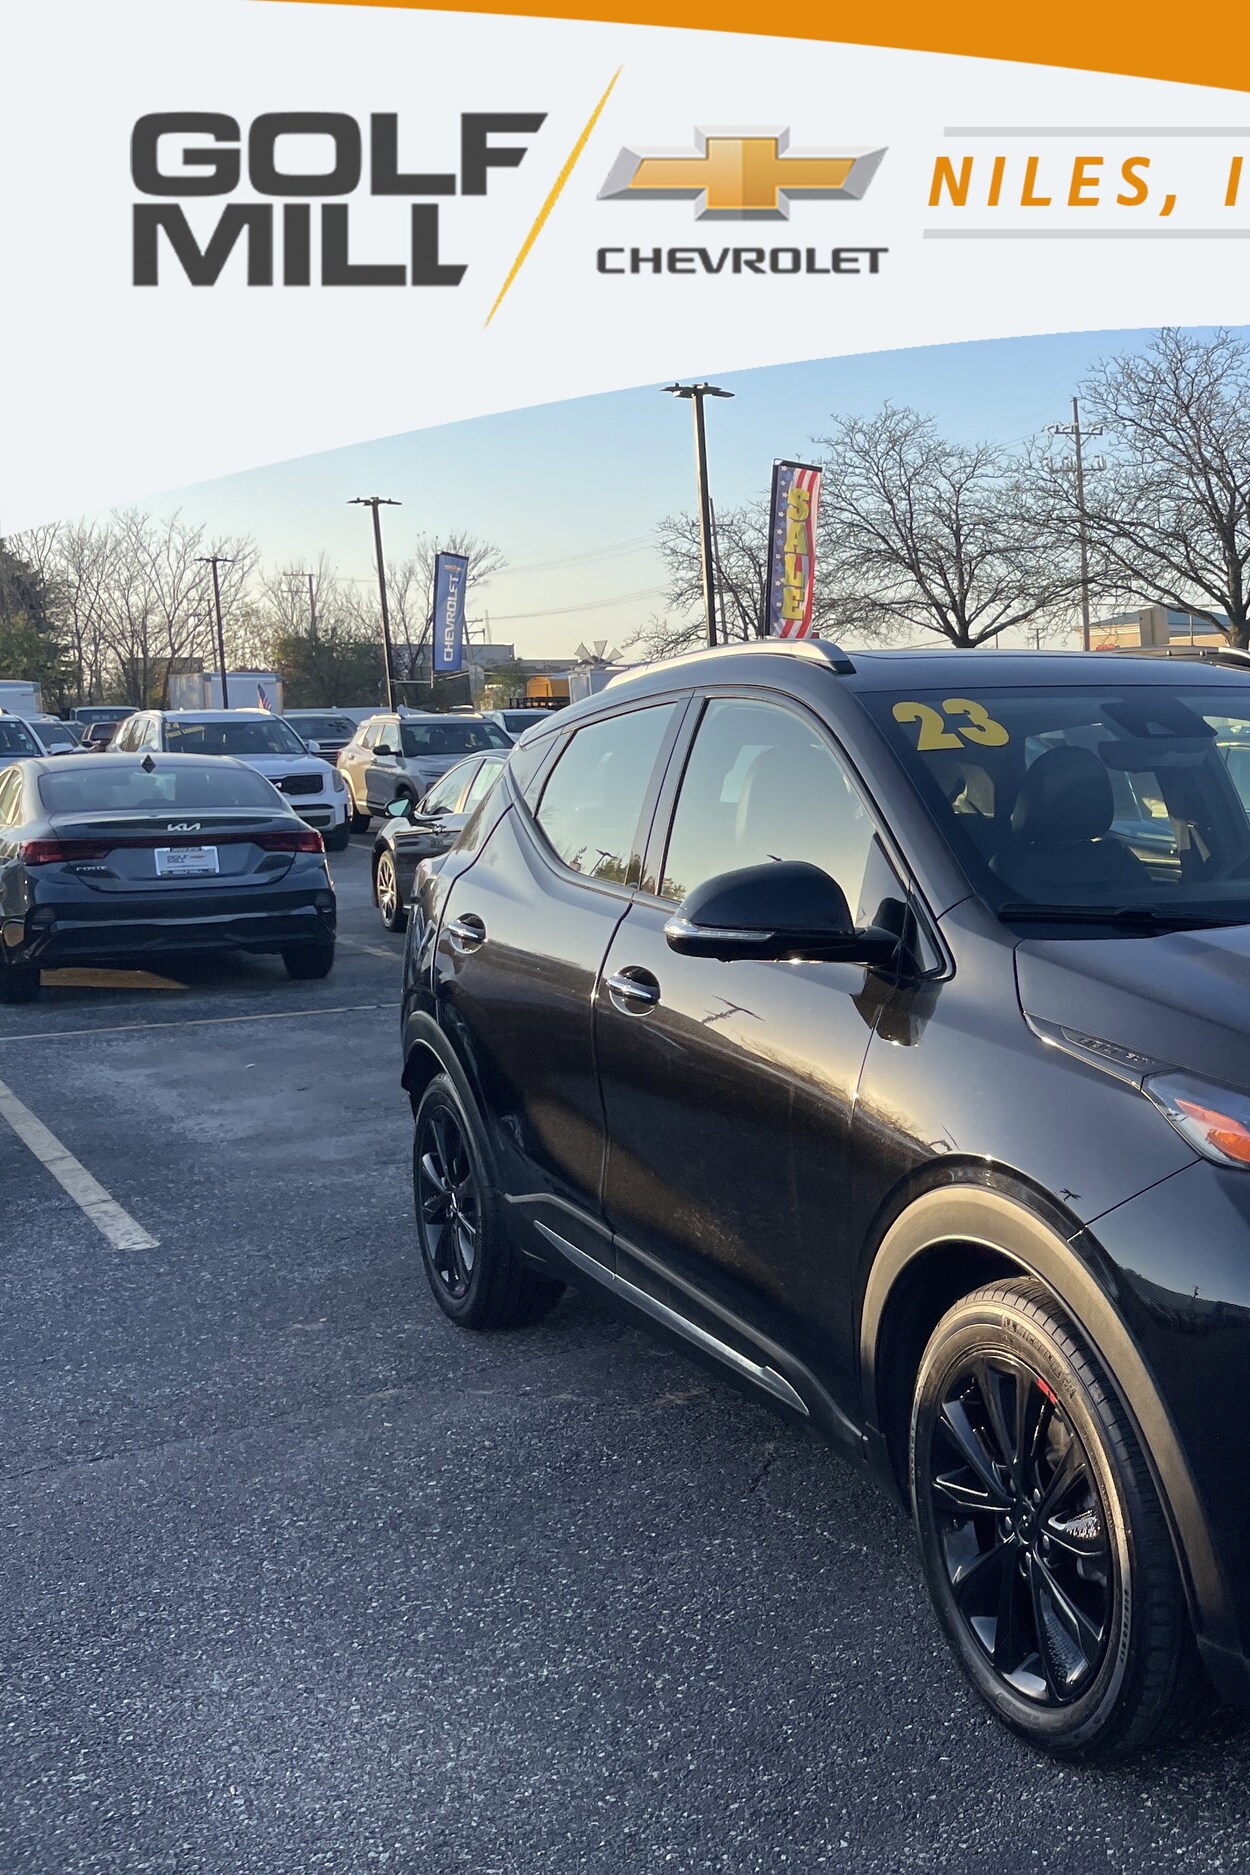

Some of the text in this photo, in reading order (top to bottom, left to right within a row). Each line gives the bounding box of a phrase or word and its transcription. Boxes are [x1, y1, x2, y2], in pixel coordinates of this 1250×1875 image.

[781, 487, 811, 620] SALE
[443, 573, 460, 662] CHEVROLET
[892, 698, 1010, 751] 23
[167, 822, 201, 832] KIA
